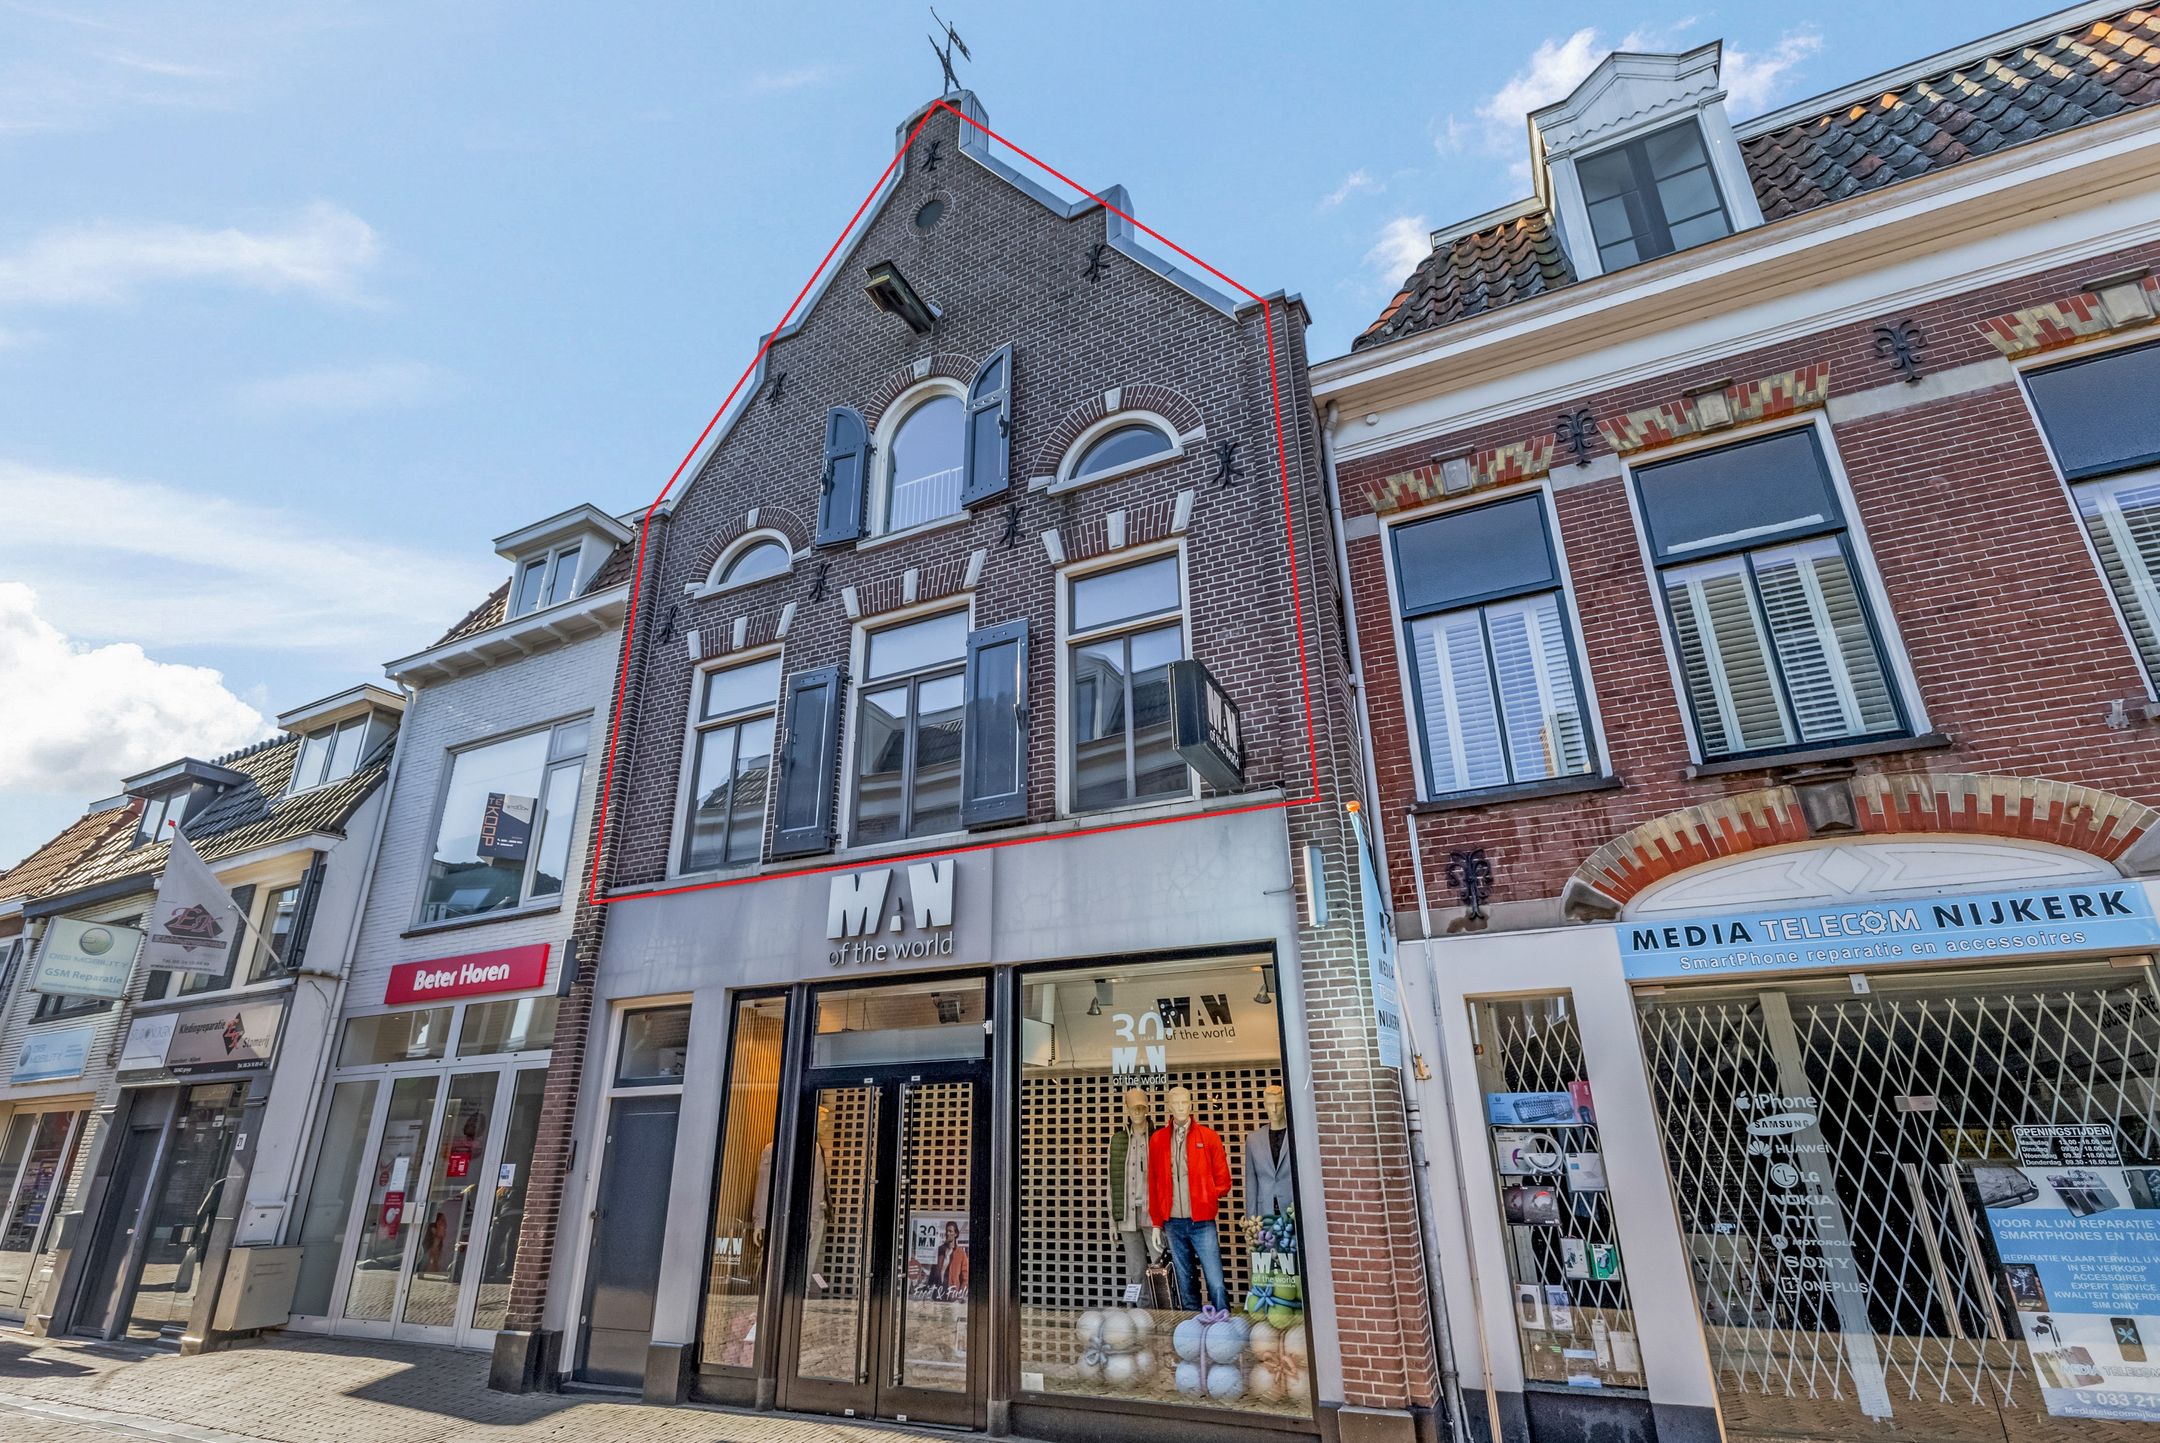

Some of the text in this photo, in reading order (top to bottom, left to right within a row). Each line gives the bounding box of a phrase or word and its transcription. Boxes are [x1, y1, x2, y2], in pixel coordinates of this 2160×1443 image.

[1215, 733, 1226, 754] the
[1225, 749, 1240, 770] world
[482, 805, 500, 847] KOOP
[826, 859, 956, 940] MAN
[1632, 889, 2135, 951] MEDIA TELECOM NIJKERK
[829, 930, 955, 966] of the world
[1679, 931, 2087, 970] SmartPhone reparatie en accessoires
[45, 967, 123, 984] GSM Reparatie
[413, 963, 510, 991] Beter Horen
[179, 1019, 226, 1035] Kledingreparatie
[1179, 1029, 1200, 1040] the
[1201, 1026, 1236, 1039] world
[242, 1035, 271, 1049] Stomerij
[1113, 1074, 1167, 1086] of the world
[1754, 1093, 1818, 1110] iPhone
[1754, 1120, 1809, 1129] SAMSUNG
[2015, 1127, 2110, 1136] OPENINGSTIJDEN
[1775, 1144, 1830, 1154] HUAWEI
[1800, 1171, 1820, 1182] LG
[1769, 1194, 1835, 1206] NOKIA
[1992, 1219, 2032, 1228] VOOR
[2035, 1219, 2051, 1228] AL
[2054, 1219, 2077, 1228] UW
[2079, 1220, 2154, 1229] REPARATIE
[2000, 1231, 2102, 1240] SMARTPHONES
[2106, 1231, 2125, 1241] EN
[1792, 1239, 1857, 1247] MOTOROLA
[1784, 1255, 1850, 1269] SONY
[2004, 1254, 2060, 1262] REPARATIE
[2061, 1255, 2096, 1263] KLAAR
[2097, 1255, 2142, 1263] TERWIJL
[2081, 1264, 2095, 1272] EN
[2097, 1264, 2147, 1273] VERKOOP
[1275, 1276, 1296, 1284] world
[2073, 1273, 2146, 1282] ACCESSOIRES
[1803, 1281, 1869, 1293] ONEPLUS
[2071, 1282, 2156, 1291] EXPERT SERVICE
[2054, 1291, 2110, 1299] KWALITEIT
[2092, 1301, 2139, 1310] SIM ONLY
[2096, 1392, 2160, 1408] 033 21
